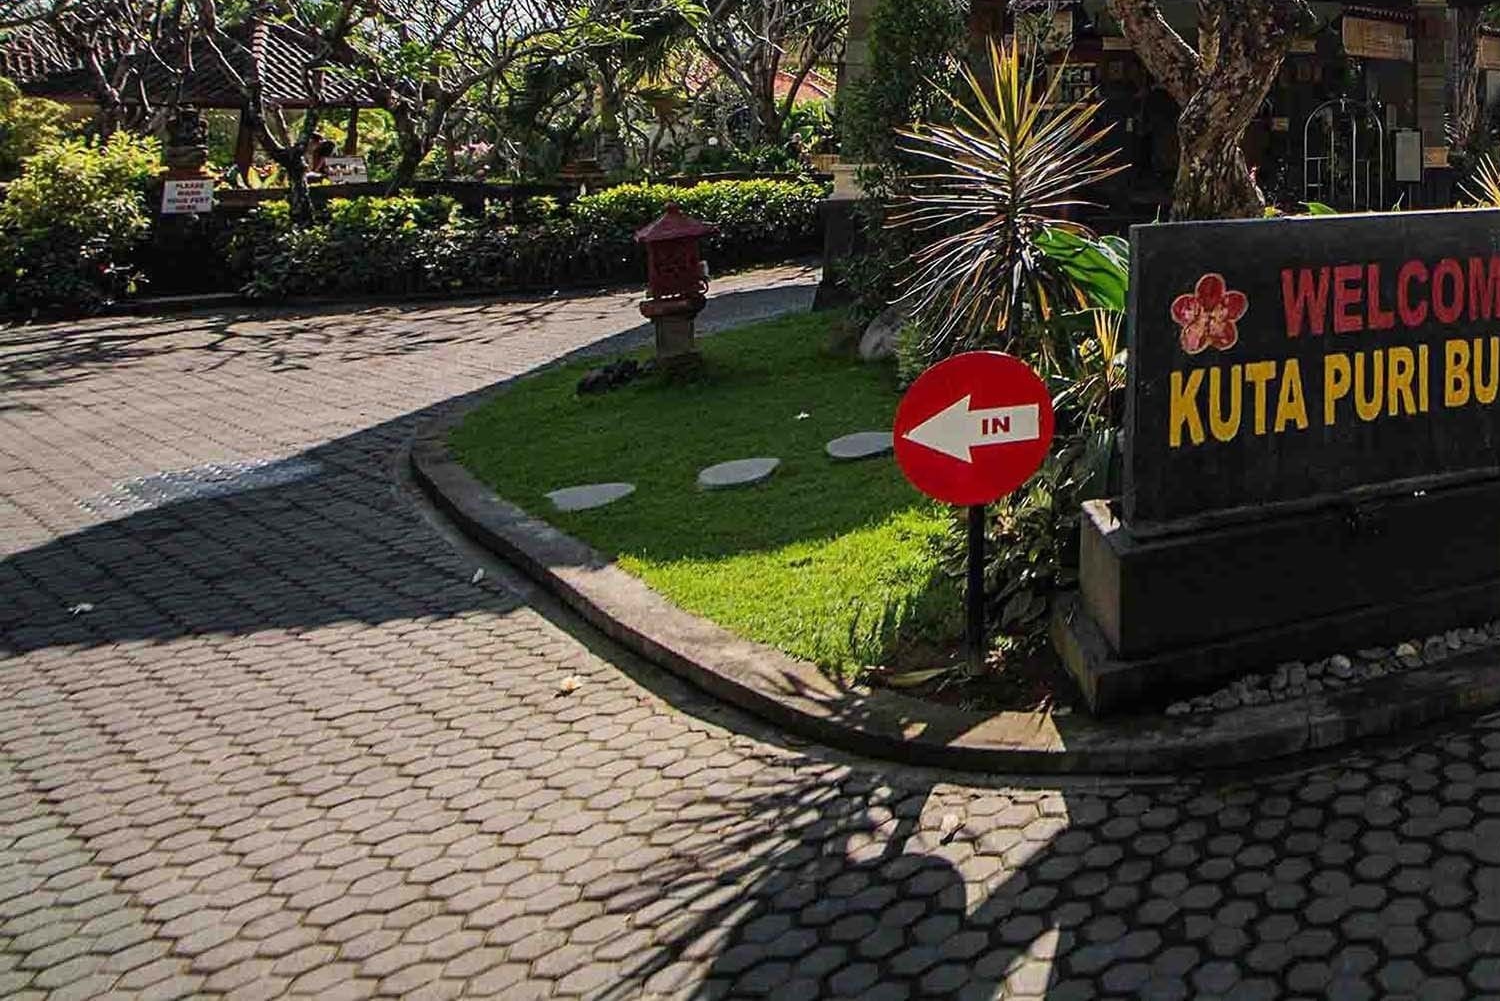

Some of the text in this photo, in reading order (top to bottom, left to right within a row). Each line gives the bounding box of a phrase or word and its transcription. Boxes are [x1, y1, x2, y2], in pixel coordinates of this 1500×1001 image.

[982, 416, 1010, 435] IN
[1168, 358, 1310, 448] KUTA
[1323, 343, 1429, 426] PURI
